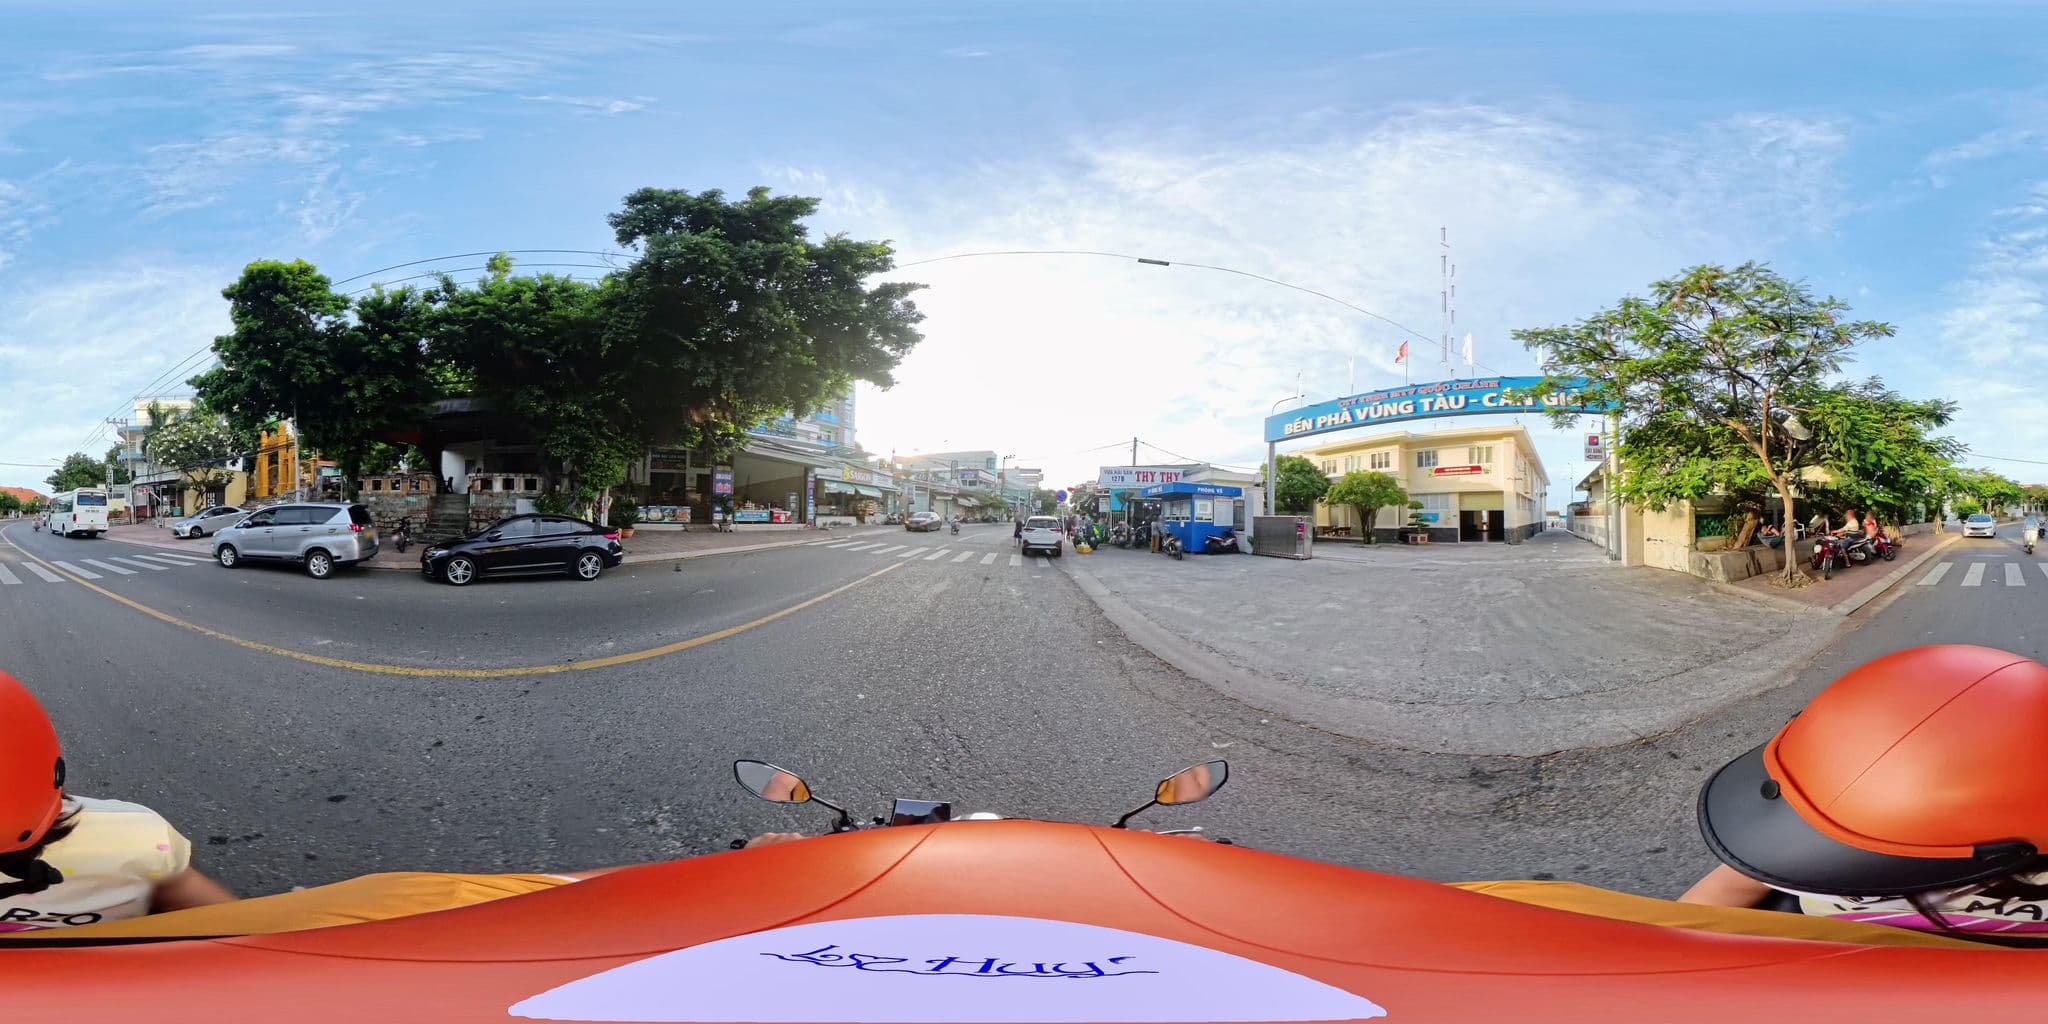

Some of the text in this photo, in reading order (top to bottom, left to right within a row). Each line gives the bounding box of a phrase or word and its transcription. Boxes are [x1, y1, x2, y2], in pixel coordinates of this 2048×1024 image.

[1284, 416, 1313, 435] BẾN
[1317, 408, 1352, 428] PHÀ
[1355, 401, 1415, 421] VŨNG
[1420, 393, 1466, 412] TÀU
[1135, 470, 1180, 483] THY THY
